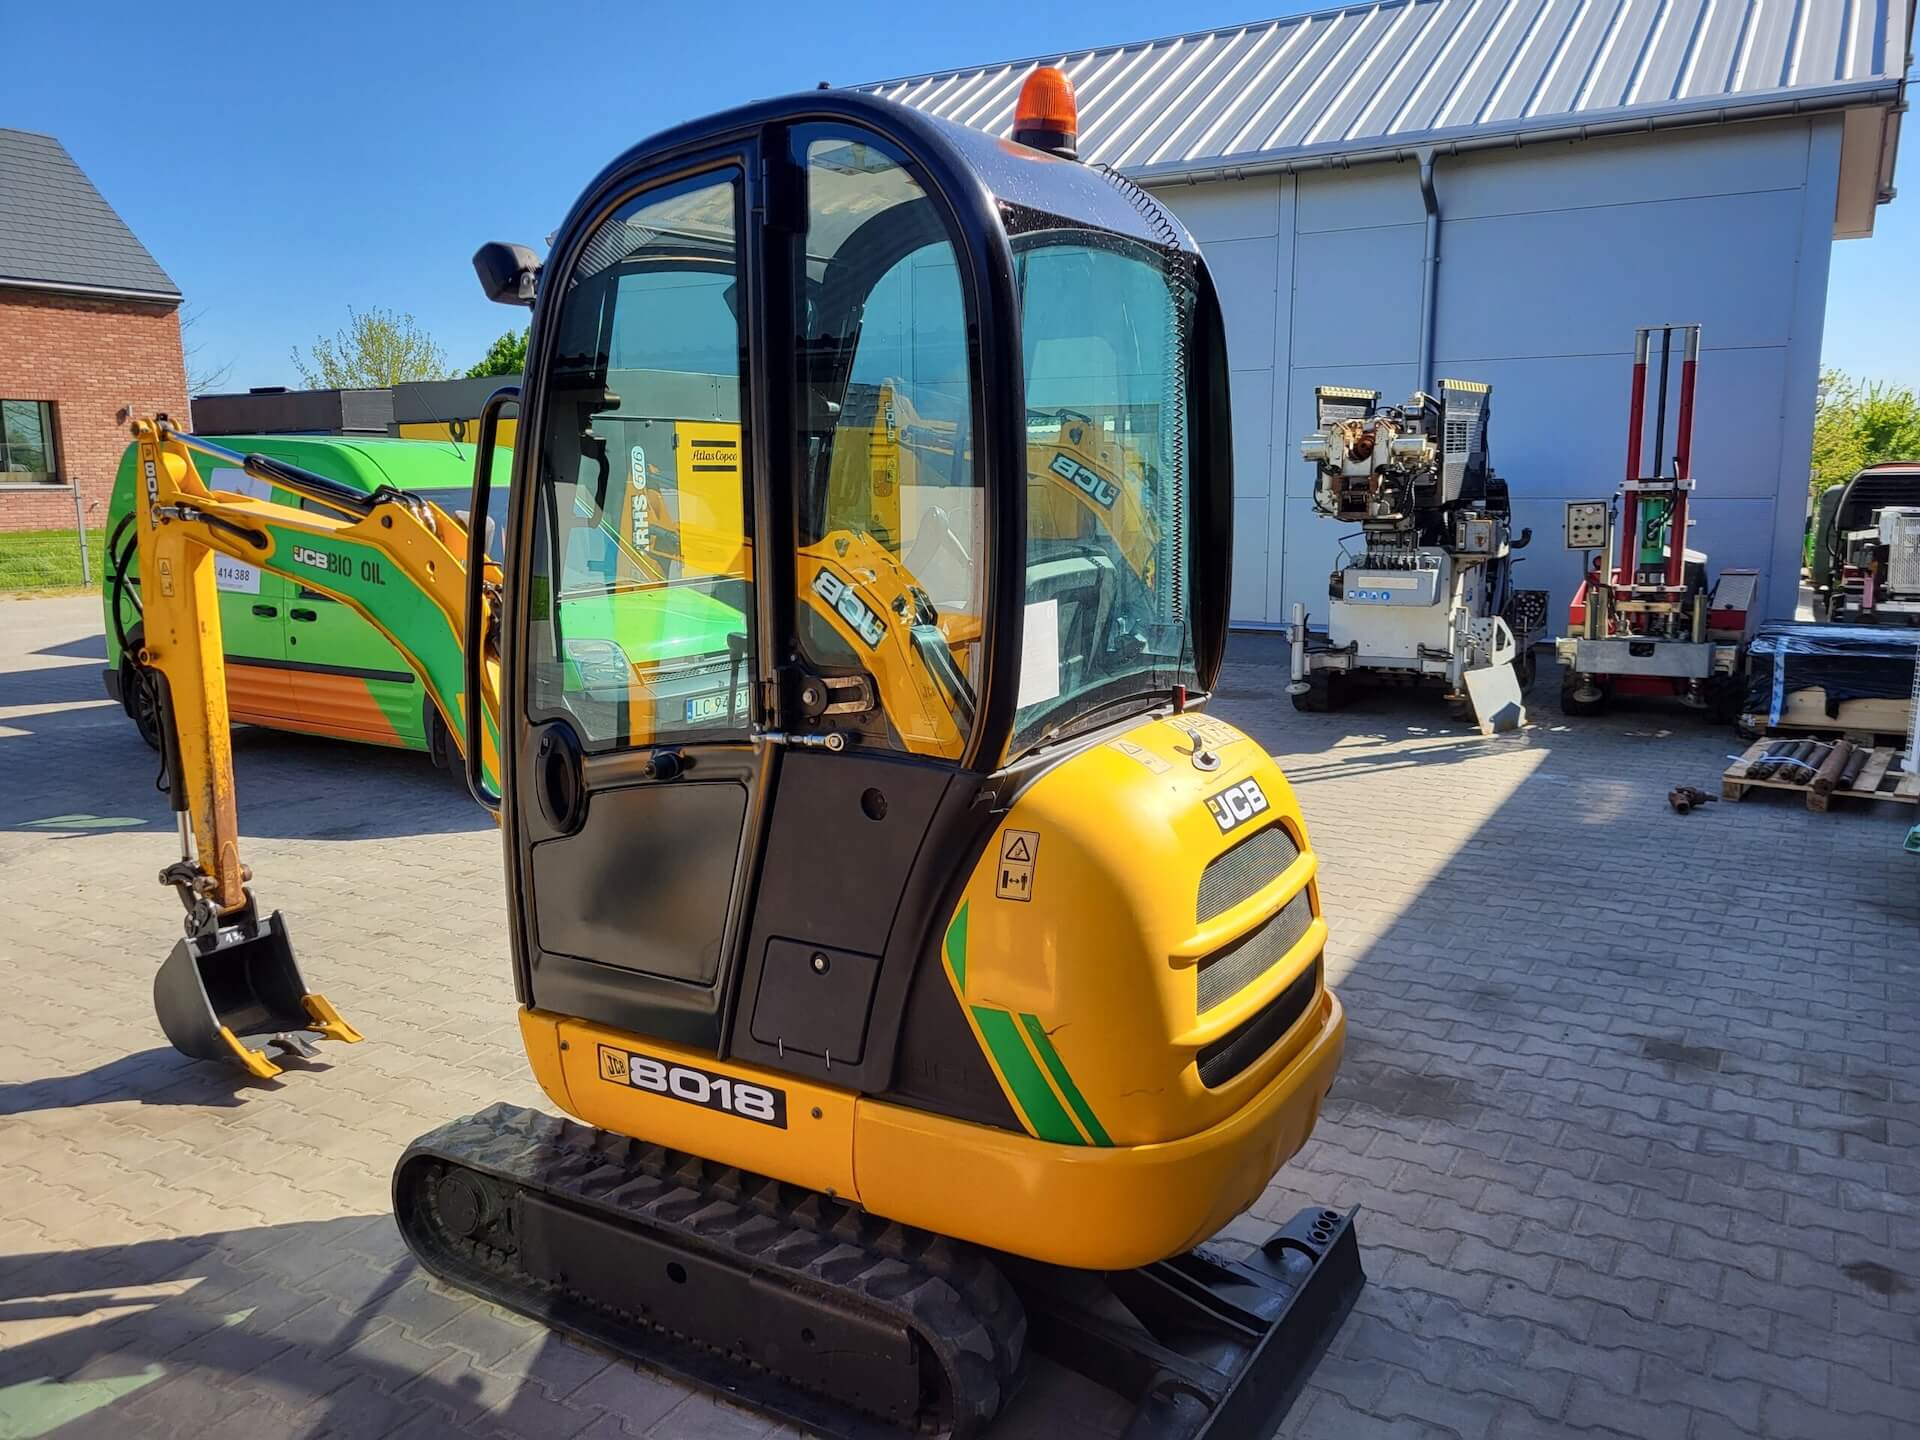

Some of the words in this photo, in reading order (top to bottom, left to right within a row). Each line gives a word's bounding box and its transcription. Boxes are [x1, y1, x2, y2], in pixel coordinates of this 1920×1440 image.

[633, 450, 645, 487] 506
[218, 567, 233, 579] 414
[234, 568, 250, 581] 388
[293, 547, 329, 570] JCB
[328, 552, 352, 577] BIO
[361, 560, 386, 585] OIL
[695, 699, 711, 716] LC
[715, 691, 748, 712] 9431
[1216, 780, 1267, 829] JCB
[607, 1054, 626, 1075] JCB
[630, 1056, 776, 1121] 8018
